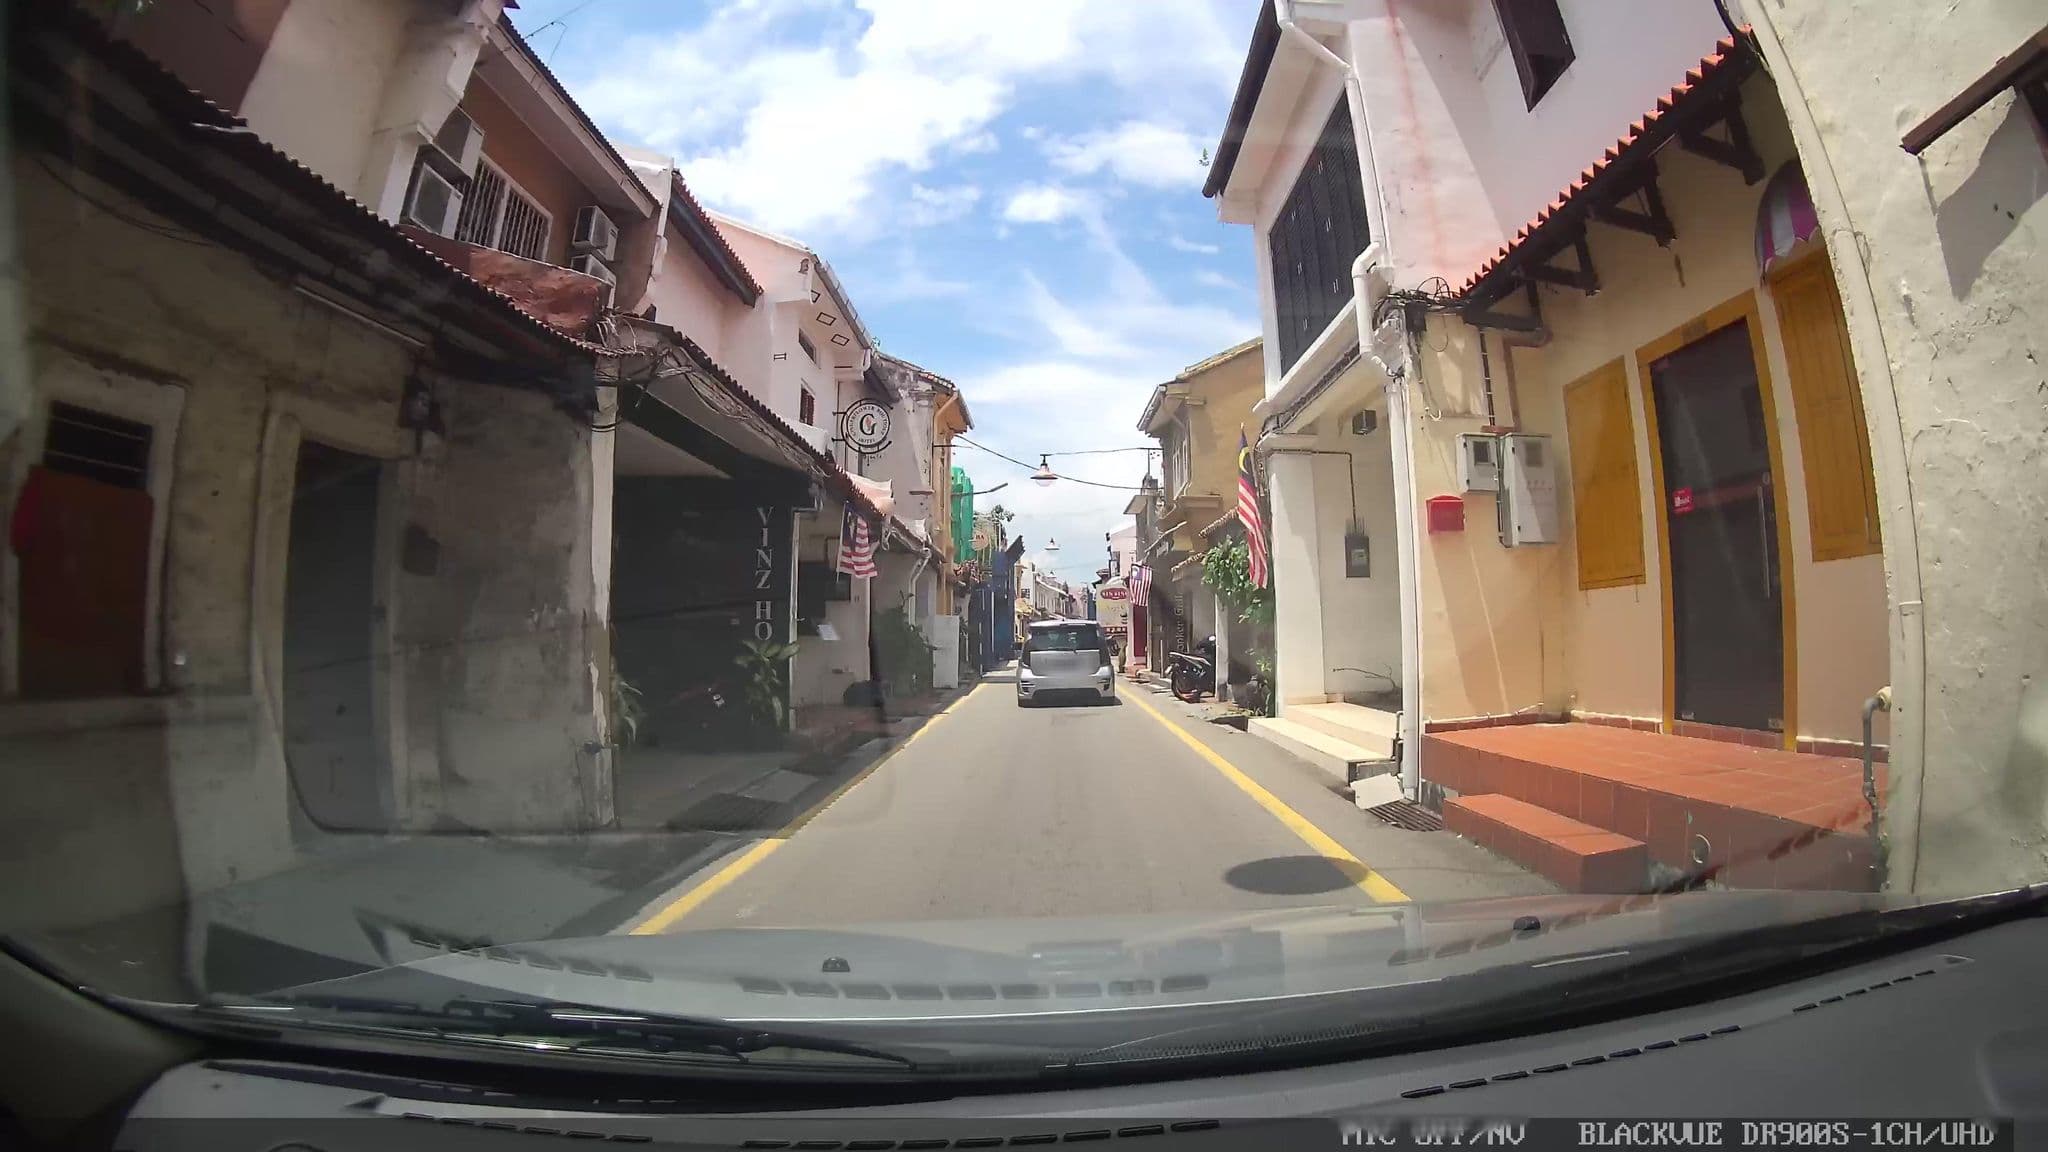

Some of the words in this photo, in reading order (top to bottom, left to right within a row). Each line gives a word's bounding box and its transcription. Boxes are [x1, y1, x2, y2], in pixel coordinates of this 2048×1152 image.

[859, 413, 877, 436] G
[755, 506, 774, 589] VINZ
[1175, 620, 1185, 651] onker
